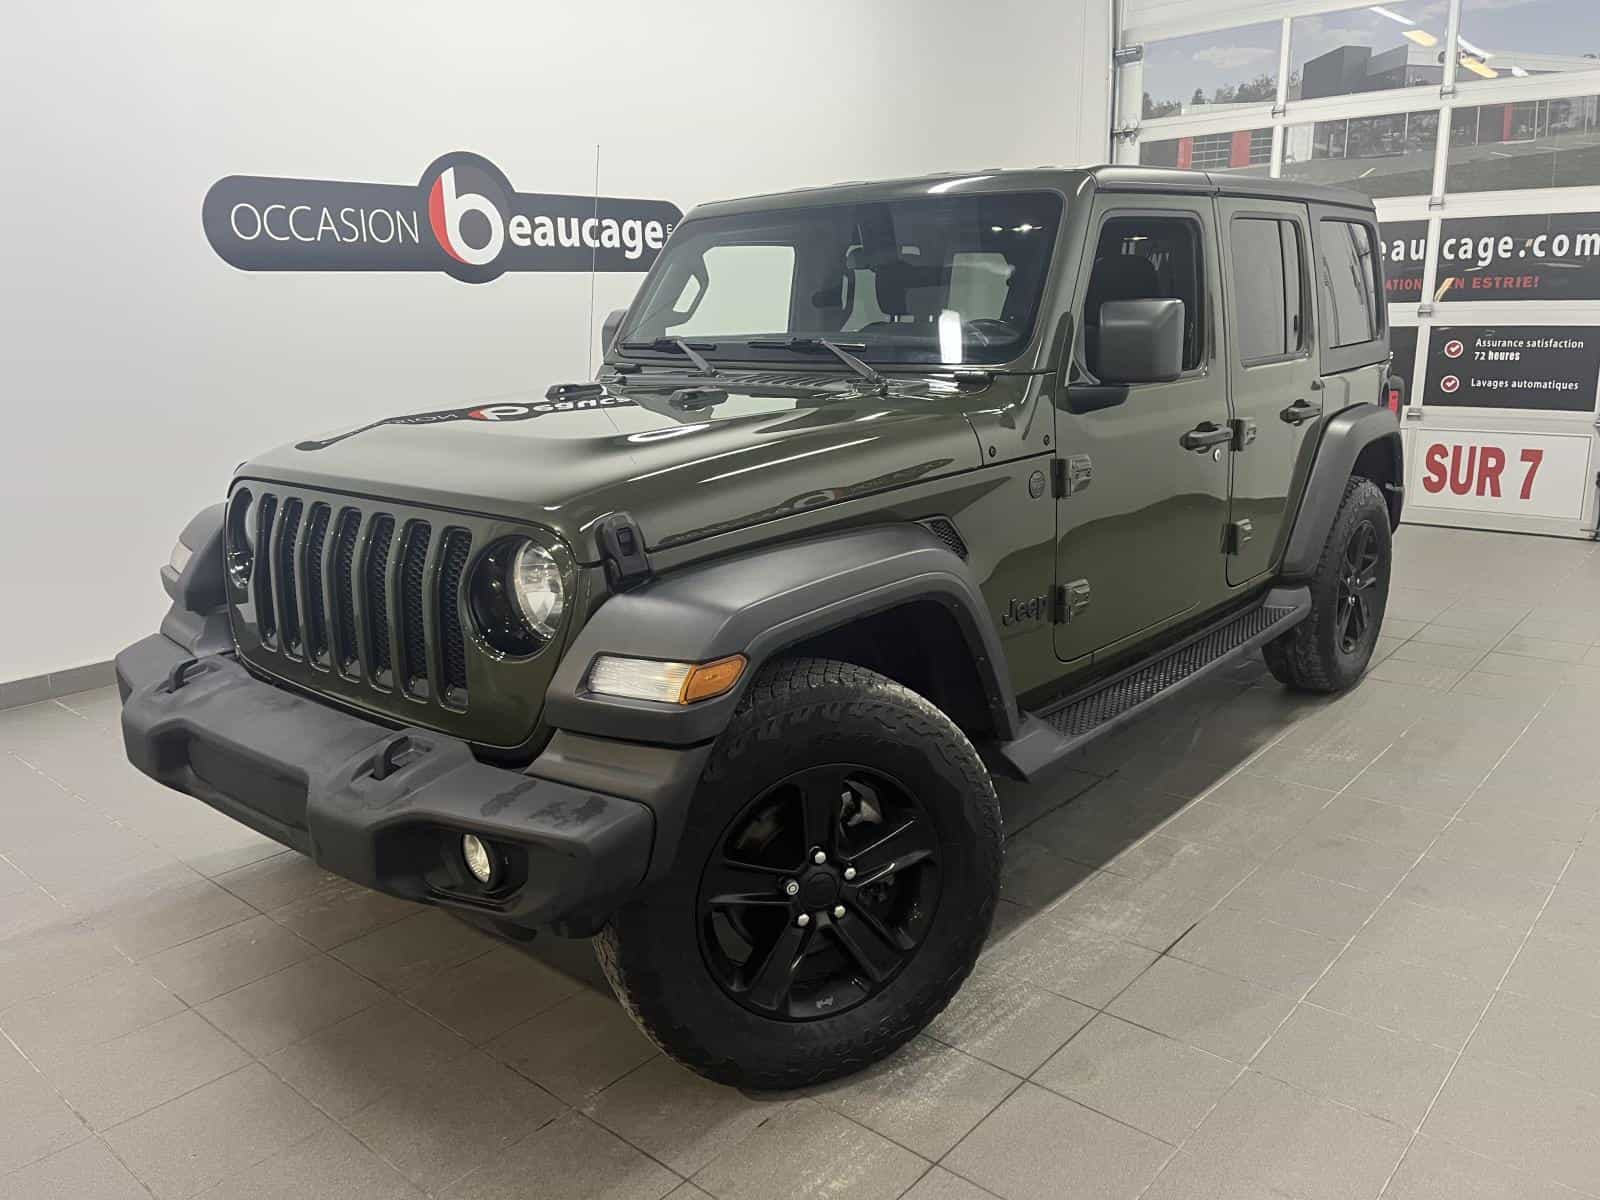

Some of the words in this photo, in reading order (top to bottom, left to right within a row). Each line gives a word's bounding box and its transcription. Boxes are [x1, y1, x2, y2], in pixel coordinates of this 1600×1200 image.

[230, 202, 419, 244] OCCASION
[1471, 275, 1541, 289] ESTRIE!
[1475, 337, 1524, 348] Assurance
[1526, 338, 1584, 349] satisfaction
[1474, 351, 1486, 361] 72
[1487, 350, 1520, 361] heures
[1471, 377, 1509, 390] Lavages
[1511, 379, 1579, 392] automatiques
[1422, 443, 1507, 498] SUR
[1519, 448, 1545, 500] 7
[1001, 595, 1048, 627] Jeep
